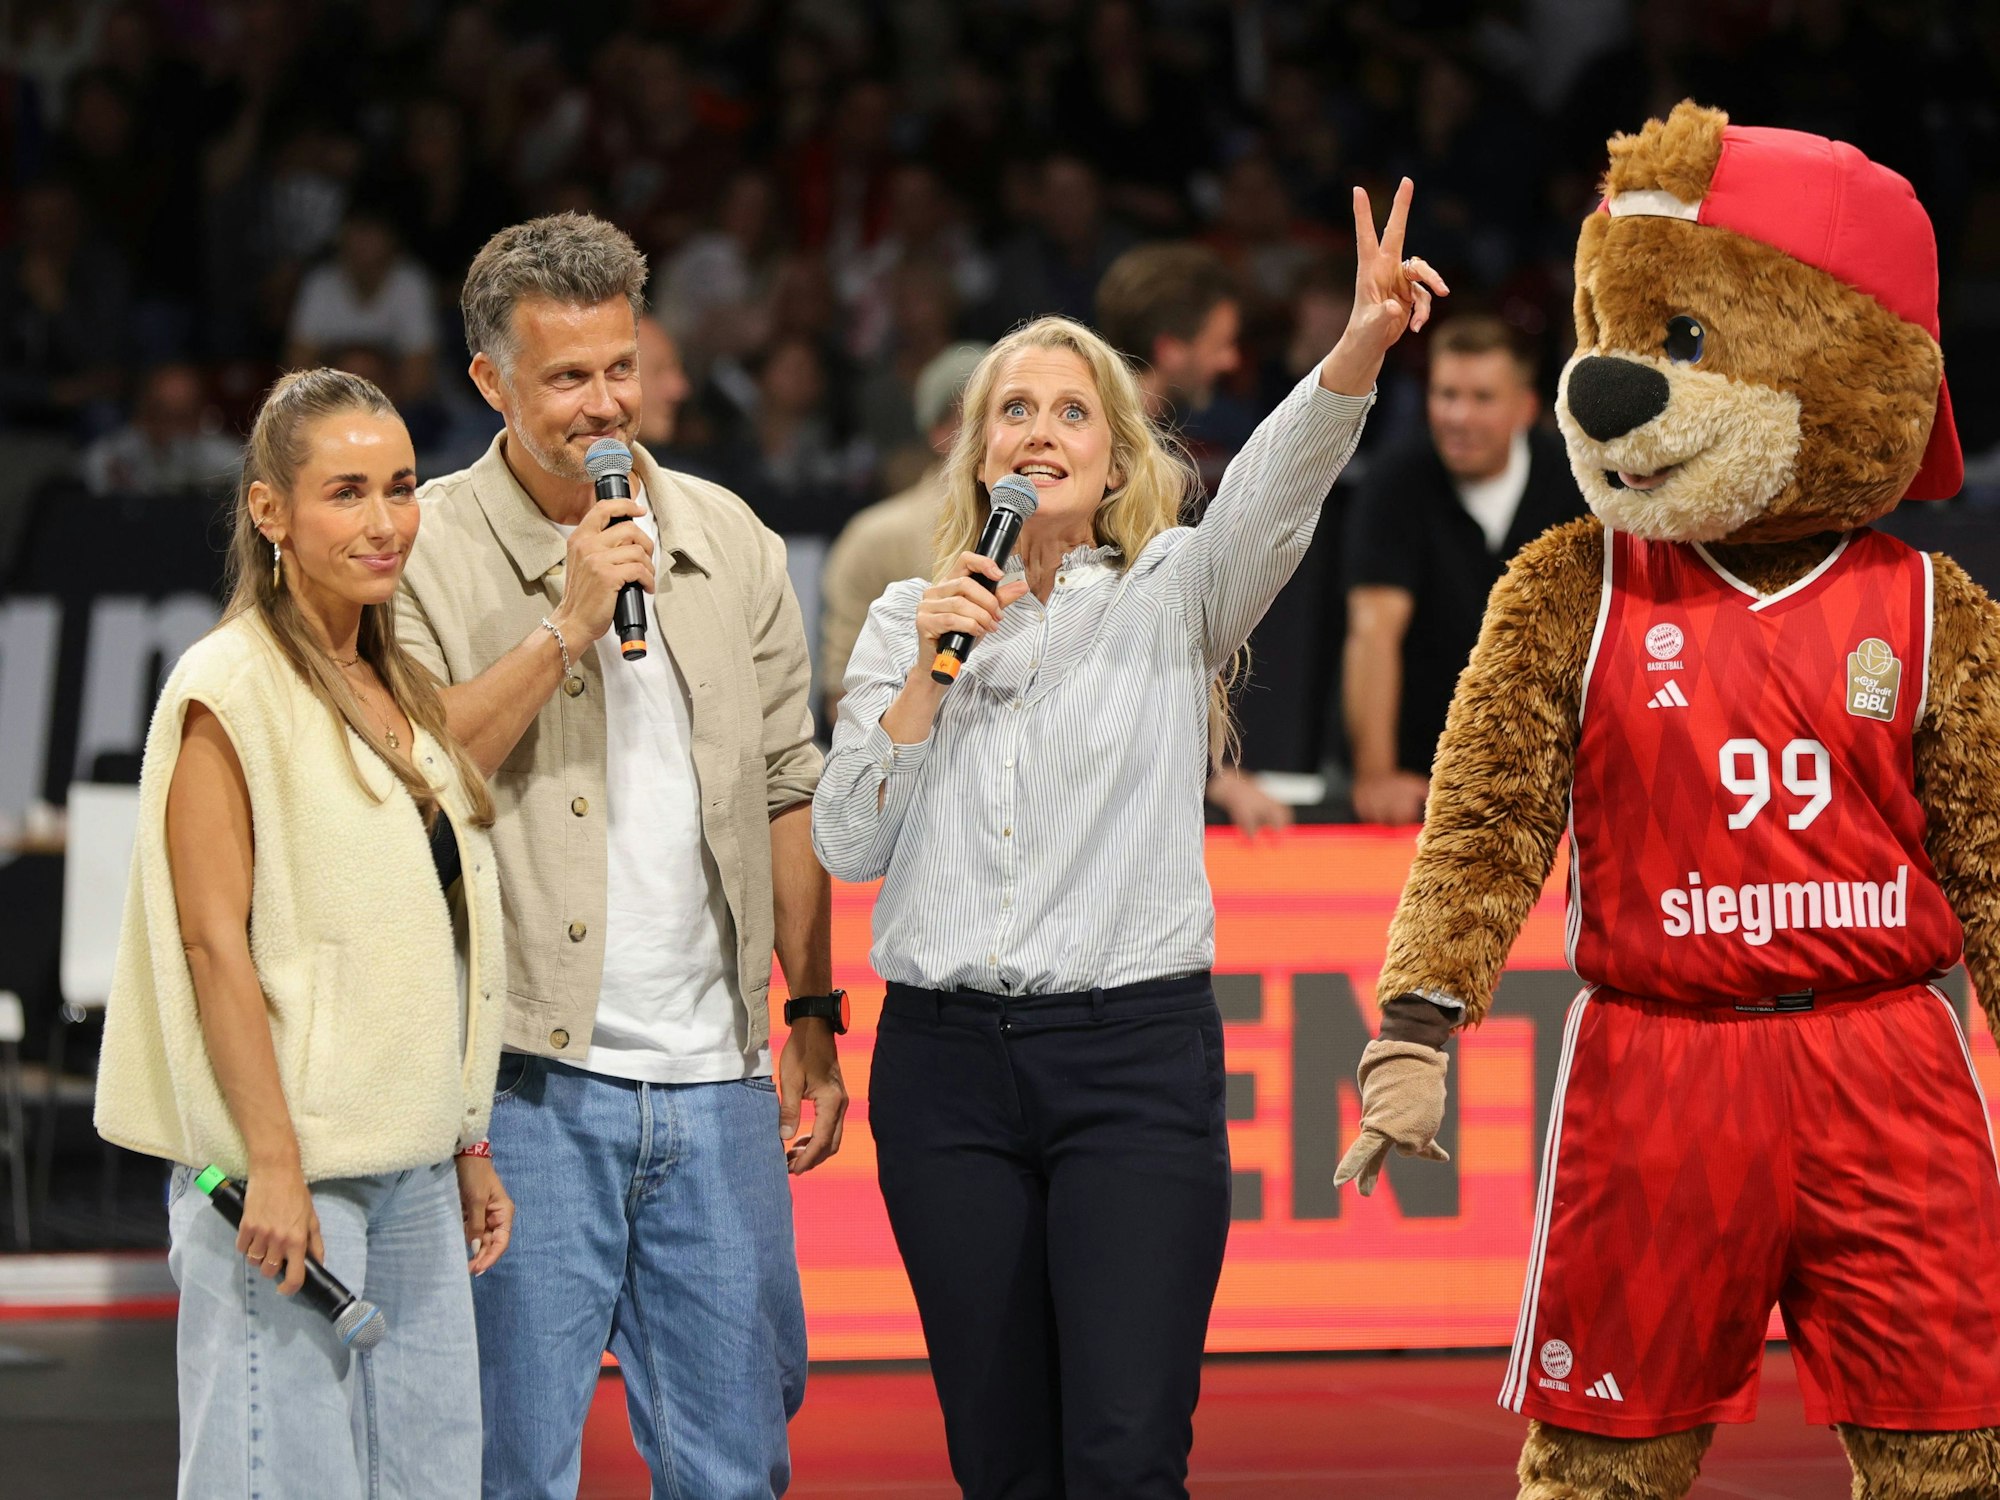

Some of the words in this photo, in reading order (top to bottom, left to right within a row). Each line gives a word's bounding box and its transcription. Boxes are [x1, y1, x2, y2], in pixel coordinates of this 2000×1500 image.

[1647, 660, 1684, 672] BASKETBALL
[1853, 692, 1889, 714] BBL
[1718, 738, 1832, 830] 99
[1660, 865, 1908, 946] siegmund
[1539, 1377, 1570, 1392] BASKETBALL
